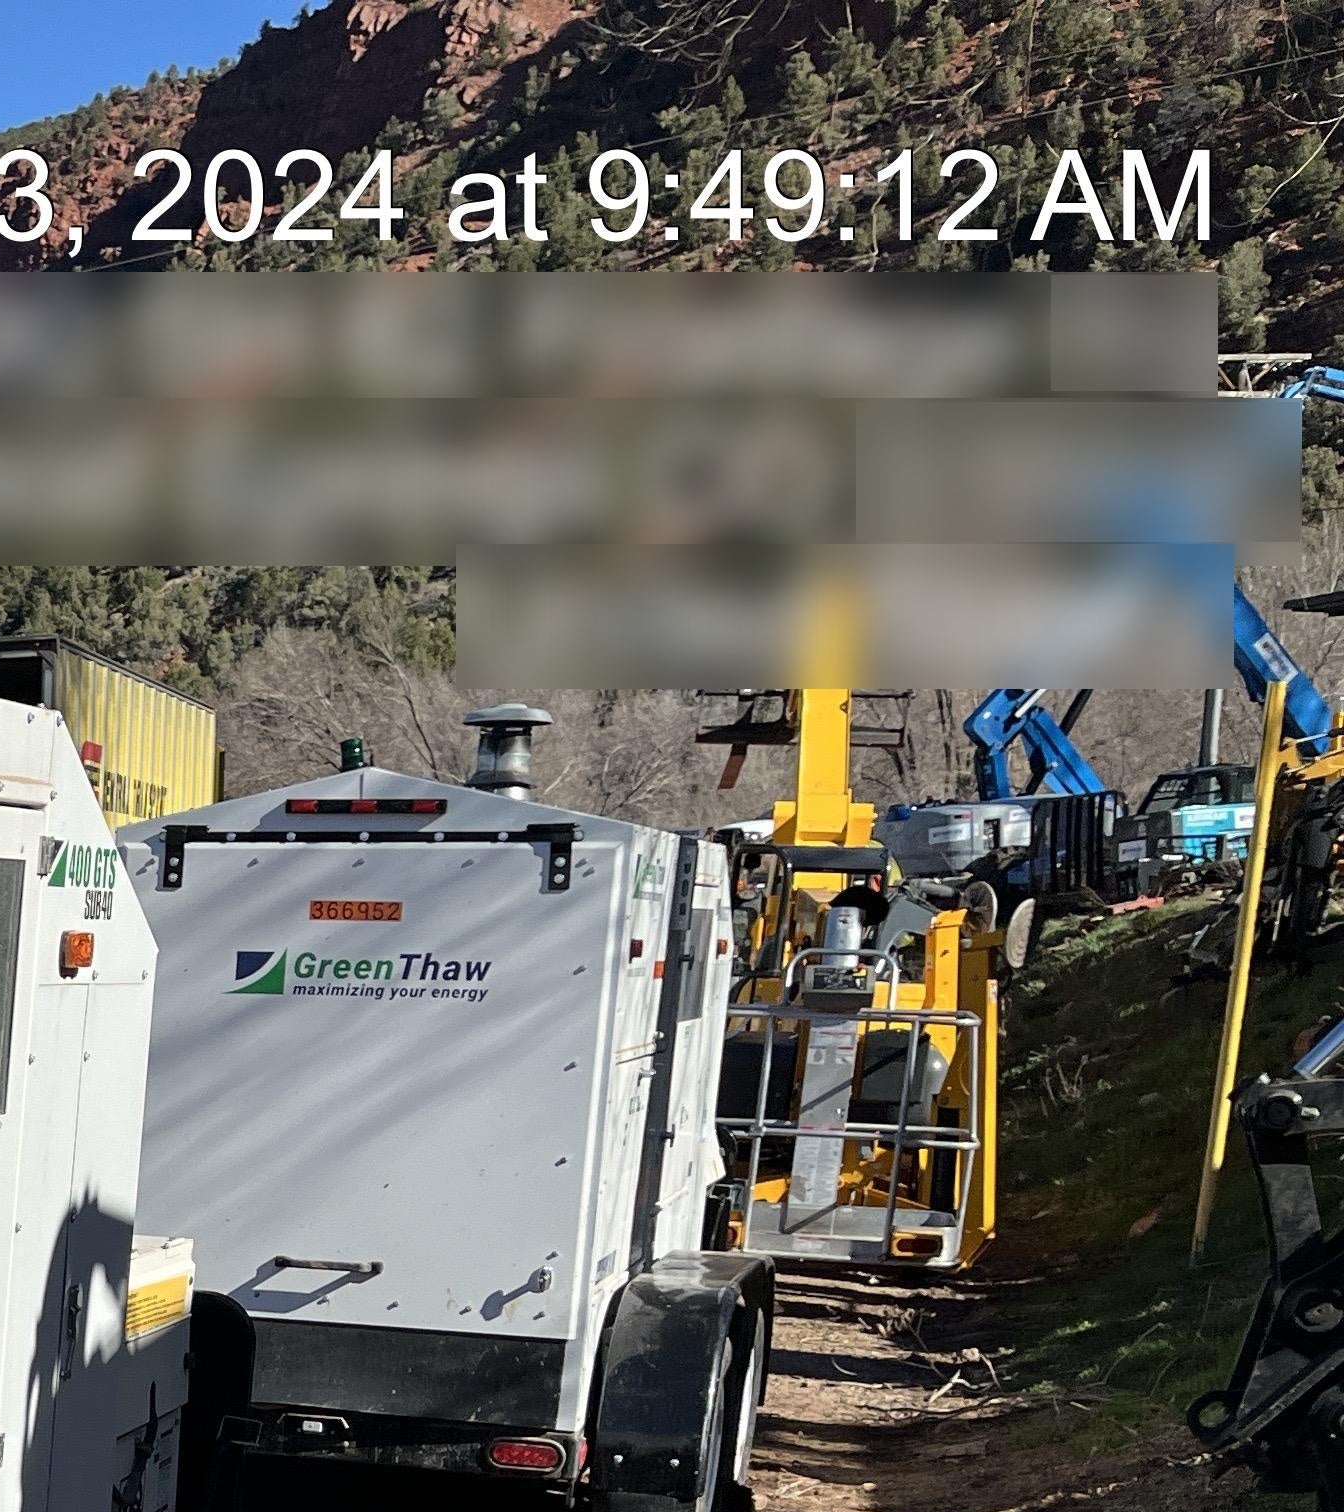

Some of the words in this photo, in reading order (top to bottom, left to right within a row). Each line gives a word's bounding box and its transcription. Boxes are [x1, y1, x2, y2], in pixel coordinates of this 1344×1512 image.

[68, 845, 91, 888] 400
[94, 848, 117, 890] GTS
[311, 901, 401, 920] 366952
[293, 983, 384, 1000] maximizing
[389, 986, 426, 1000] your
[432, 987, 488, 1002] energy
